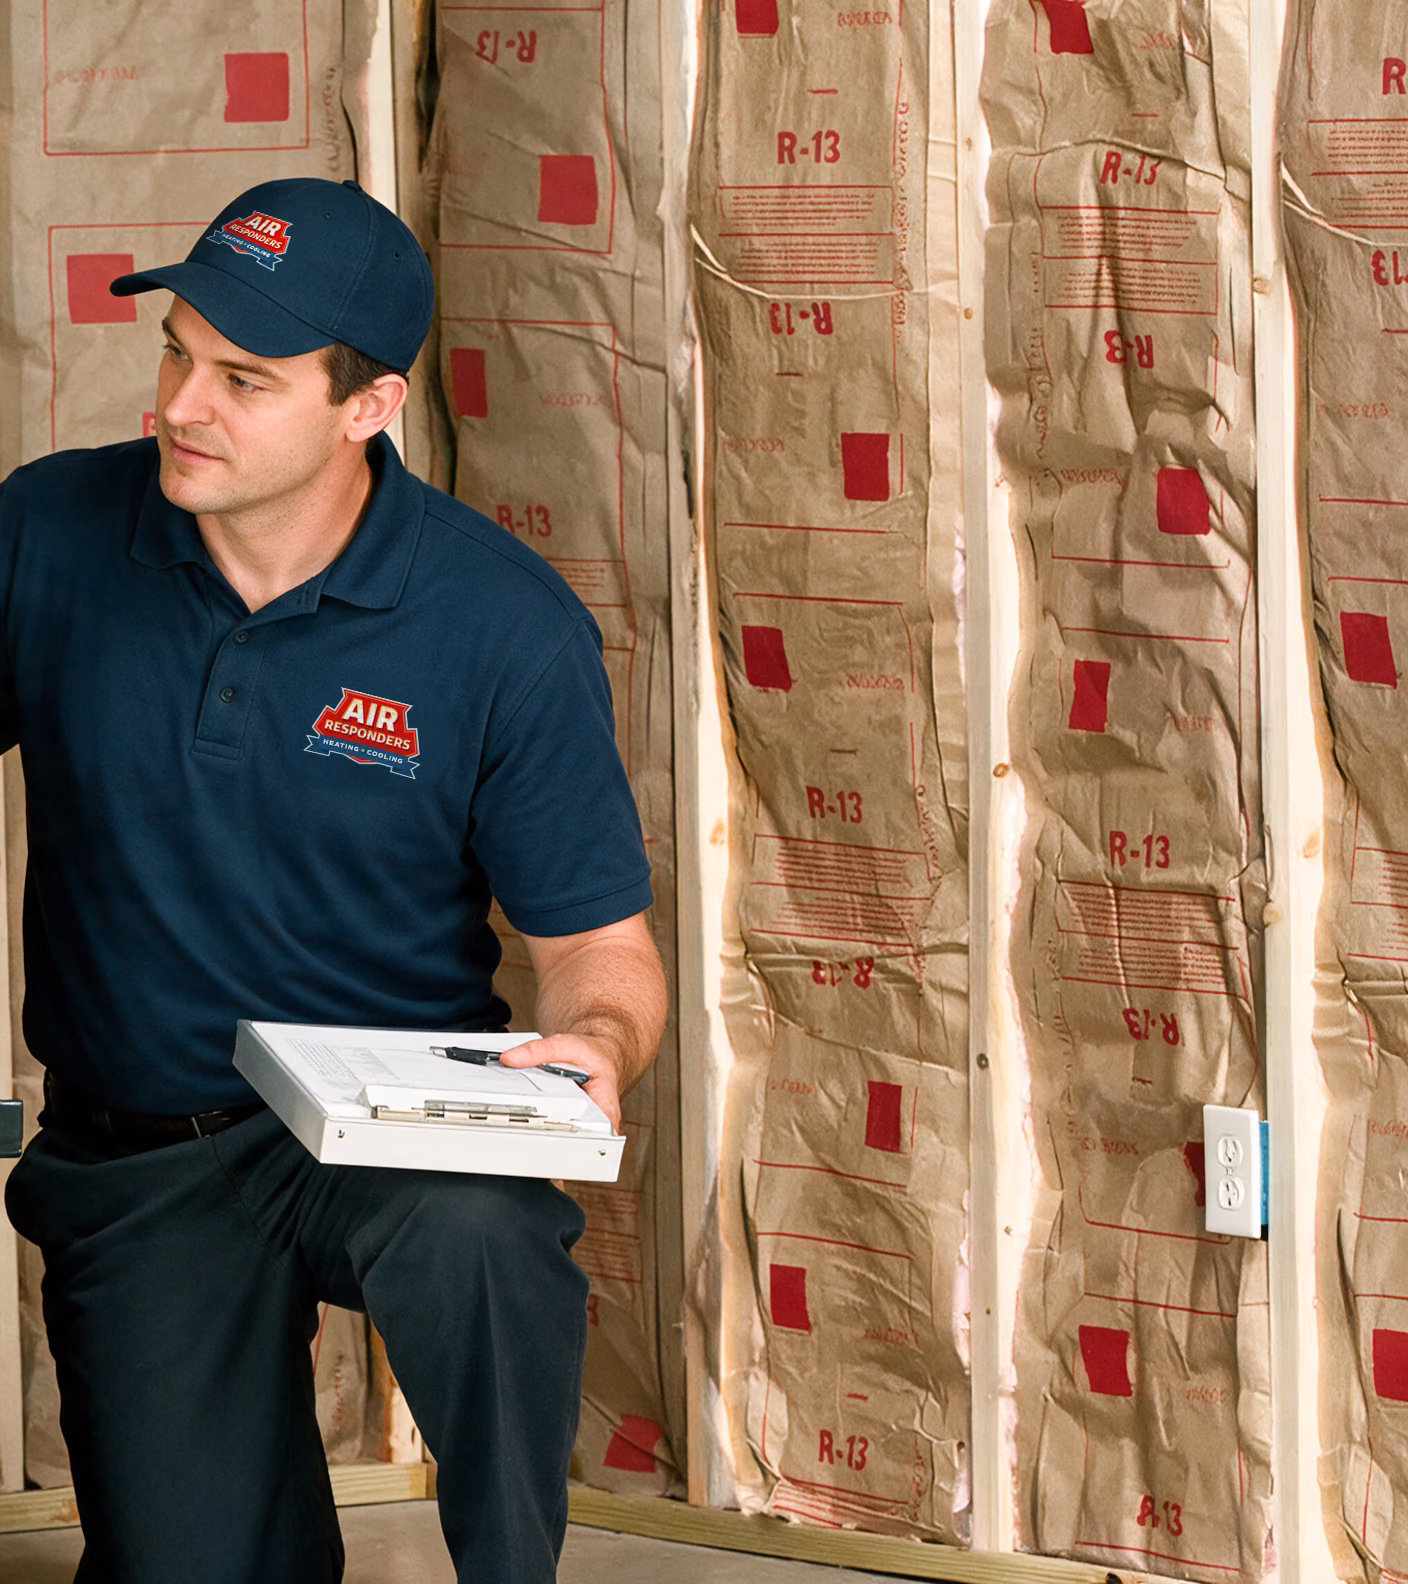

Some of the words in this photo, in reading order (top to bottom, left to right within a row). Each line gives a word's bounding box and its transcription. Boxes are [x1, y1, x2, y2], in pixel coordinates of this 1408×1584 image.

[777, 129, 841, 165] R-13
[229, 223, 283, 249] RESPONDERS
[245, 215, 282, 237] AIR
[221, 233, 244, 245] HEATING
[246, 243, 272, 258] COOLING
[769, 301, 834, 336] R-13
[496, 504, 552, 537] R-13
[342, 697, 399, 732] AIR
[322, 738, 360, 753] HEATING
[366, 749, 404, 765] COOLING
[324, 719, 411, 750] RESPONDERS
[805, 785, 863, 825] R-13
[1109, 829, 1170, 869] R-13
[1121, 1007, 1181, 1046] R-13
[818, 1429, 869, 1471] R-13
